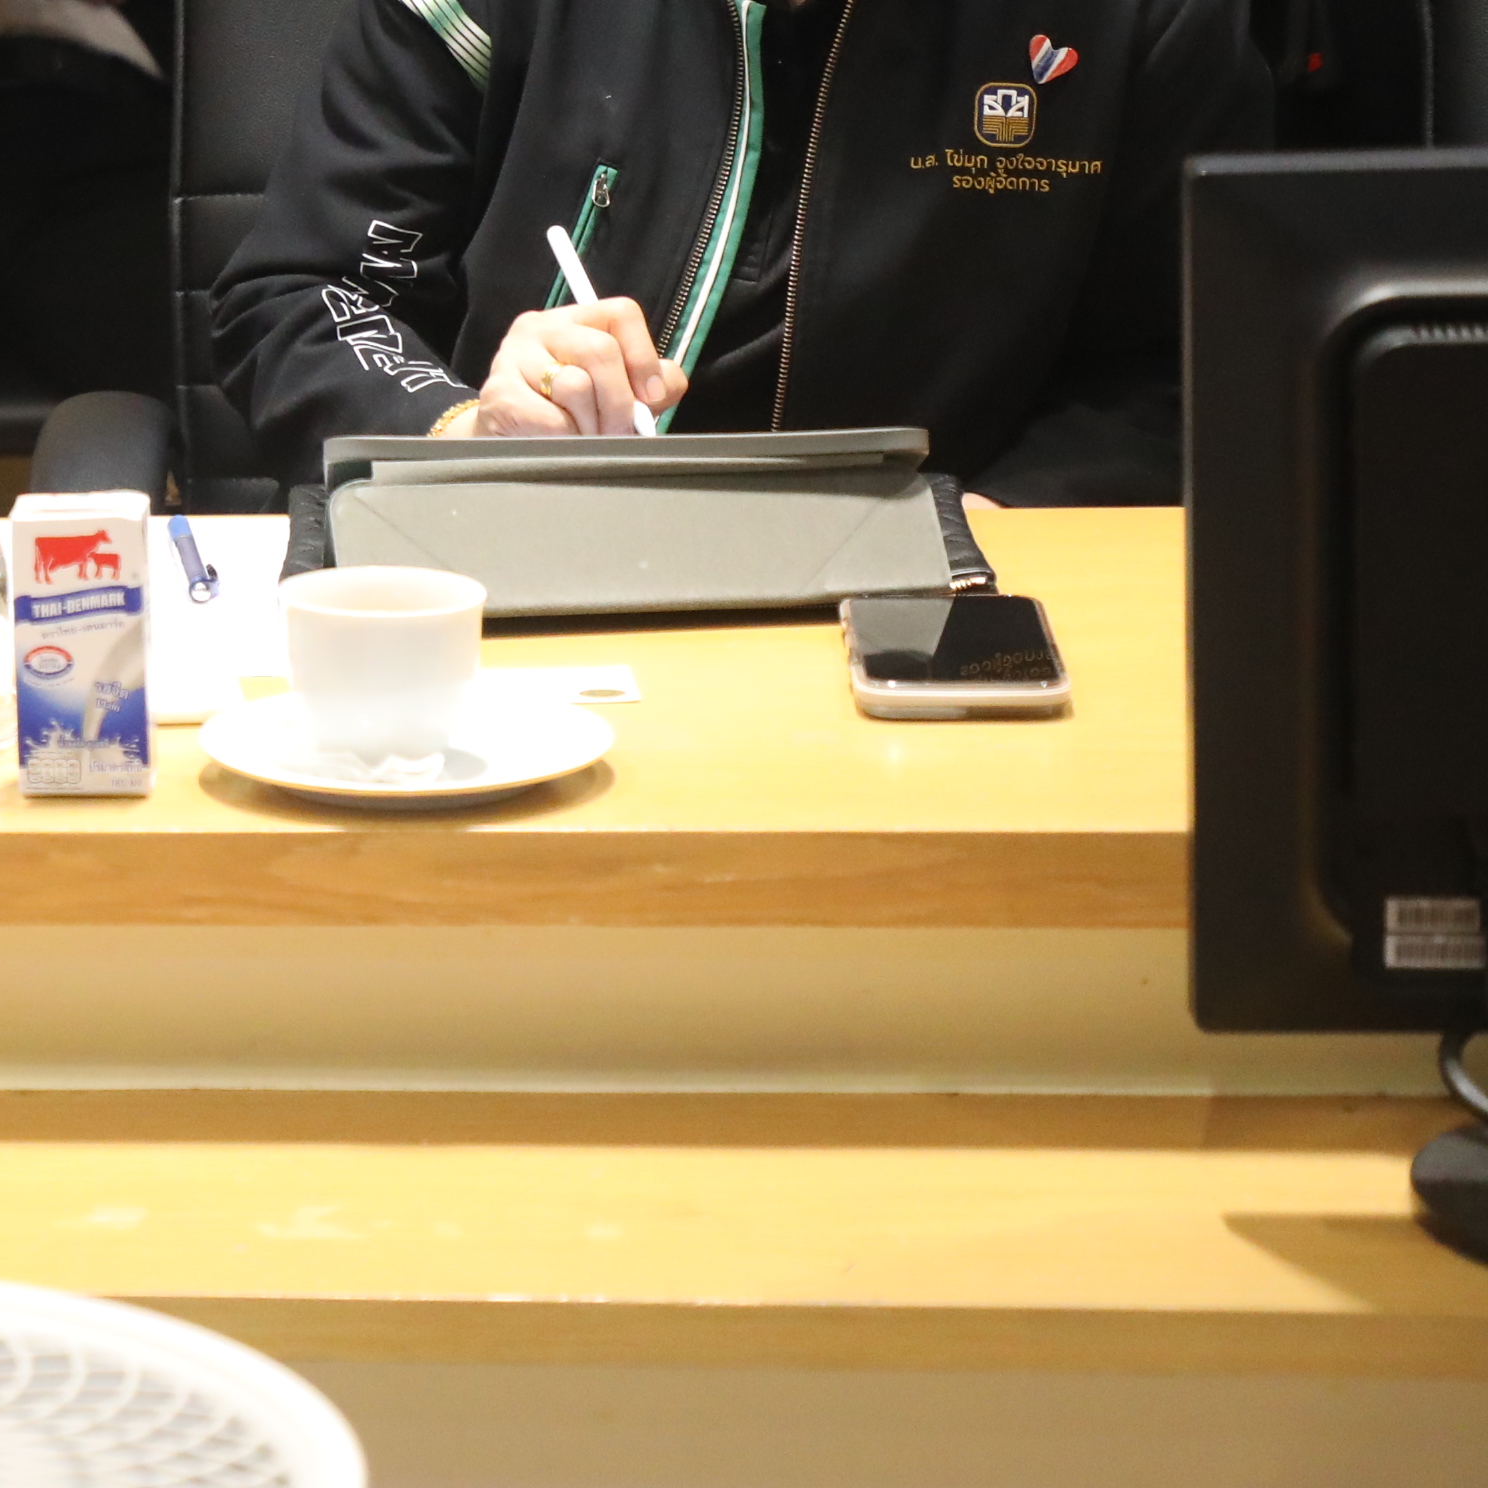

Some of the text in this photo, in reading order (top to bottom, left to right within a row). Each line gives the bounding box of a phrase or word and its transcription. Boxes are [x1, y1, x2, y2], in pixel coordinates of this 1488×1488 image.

[910, 154, 939, 169] น.ส.
[945, 149, 988, 174] ไข่มุก
[952, 172, 1050, 194] รองผู้จัดการ
[32, 592, 125, 618] THAI-DENMARK
